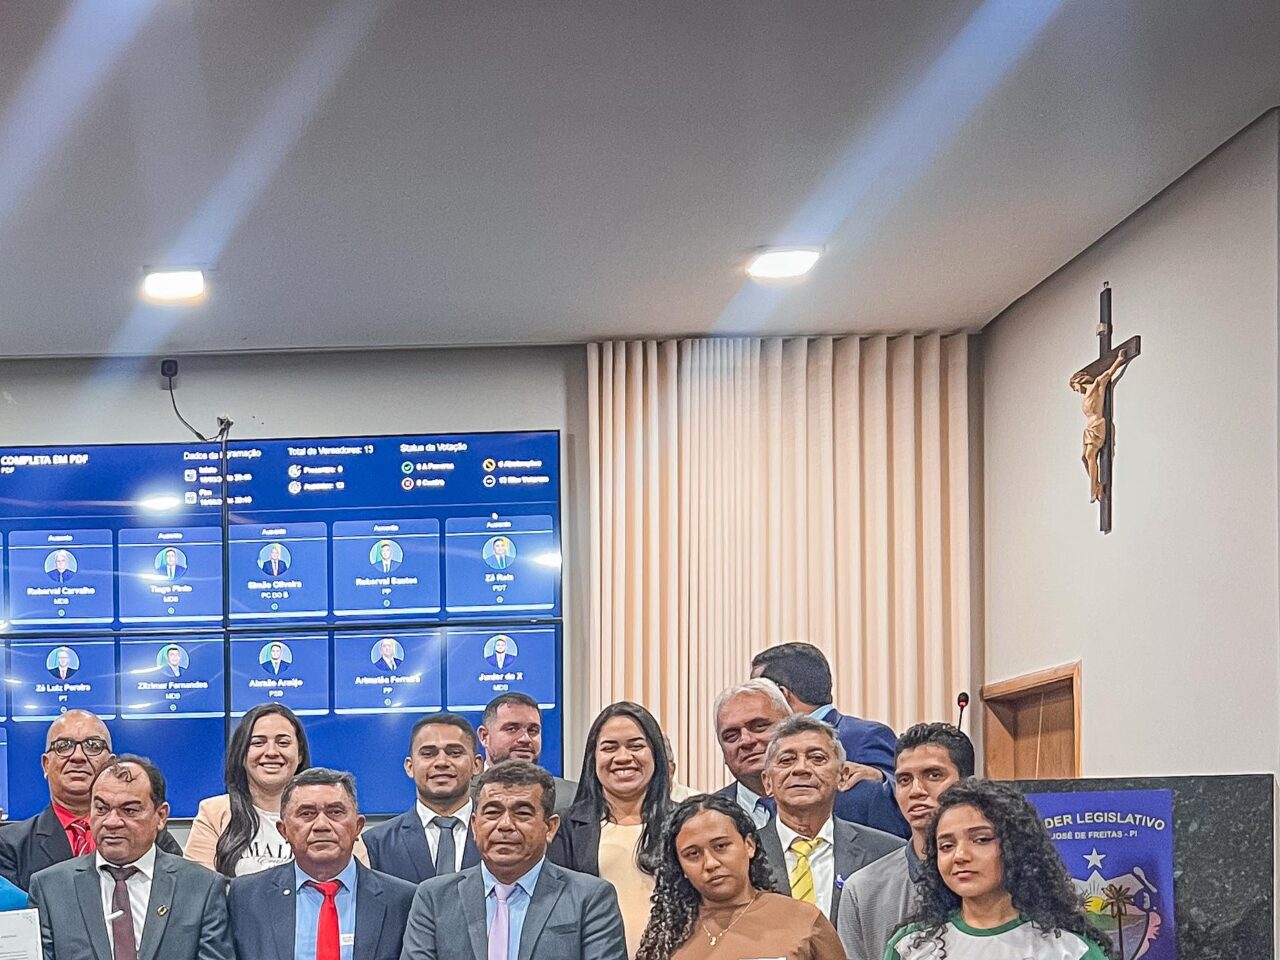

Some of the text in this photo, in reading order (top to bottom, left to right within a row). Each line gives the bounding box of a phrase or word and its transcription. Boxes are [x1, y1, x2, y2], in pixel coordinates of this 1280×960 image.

[364, 445, 373, 453] 13
[437, 443, 467, 451] Votação
[1, 456, 51, 465] COMPLETA
[53, 455, 68, 464] EM
[69, 455, 88, 464] PDF
[184, 452, 207, 460] Dados
[1044, 812, 1165, 831] DER LEGISLATIVO
[1051, 831, 1072, 840] JOSÉ
[1074, 831, 1086, 840] DE
[1088, 830, 1122, 839] FREITAS
